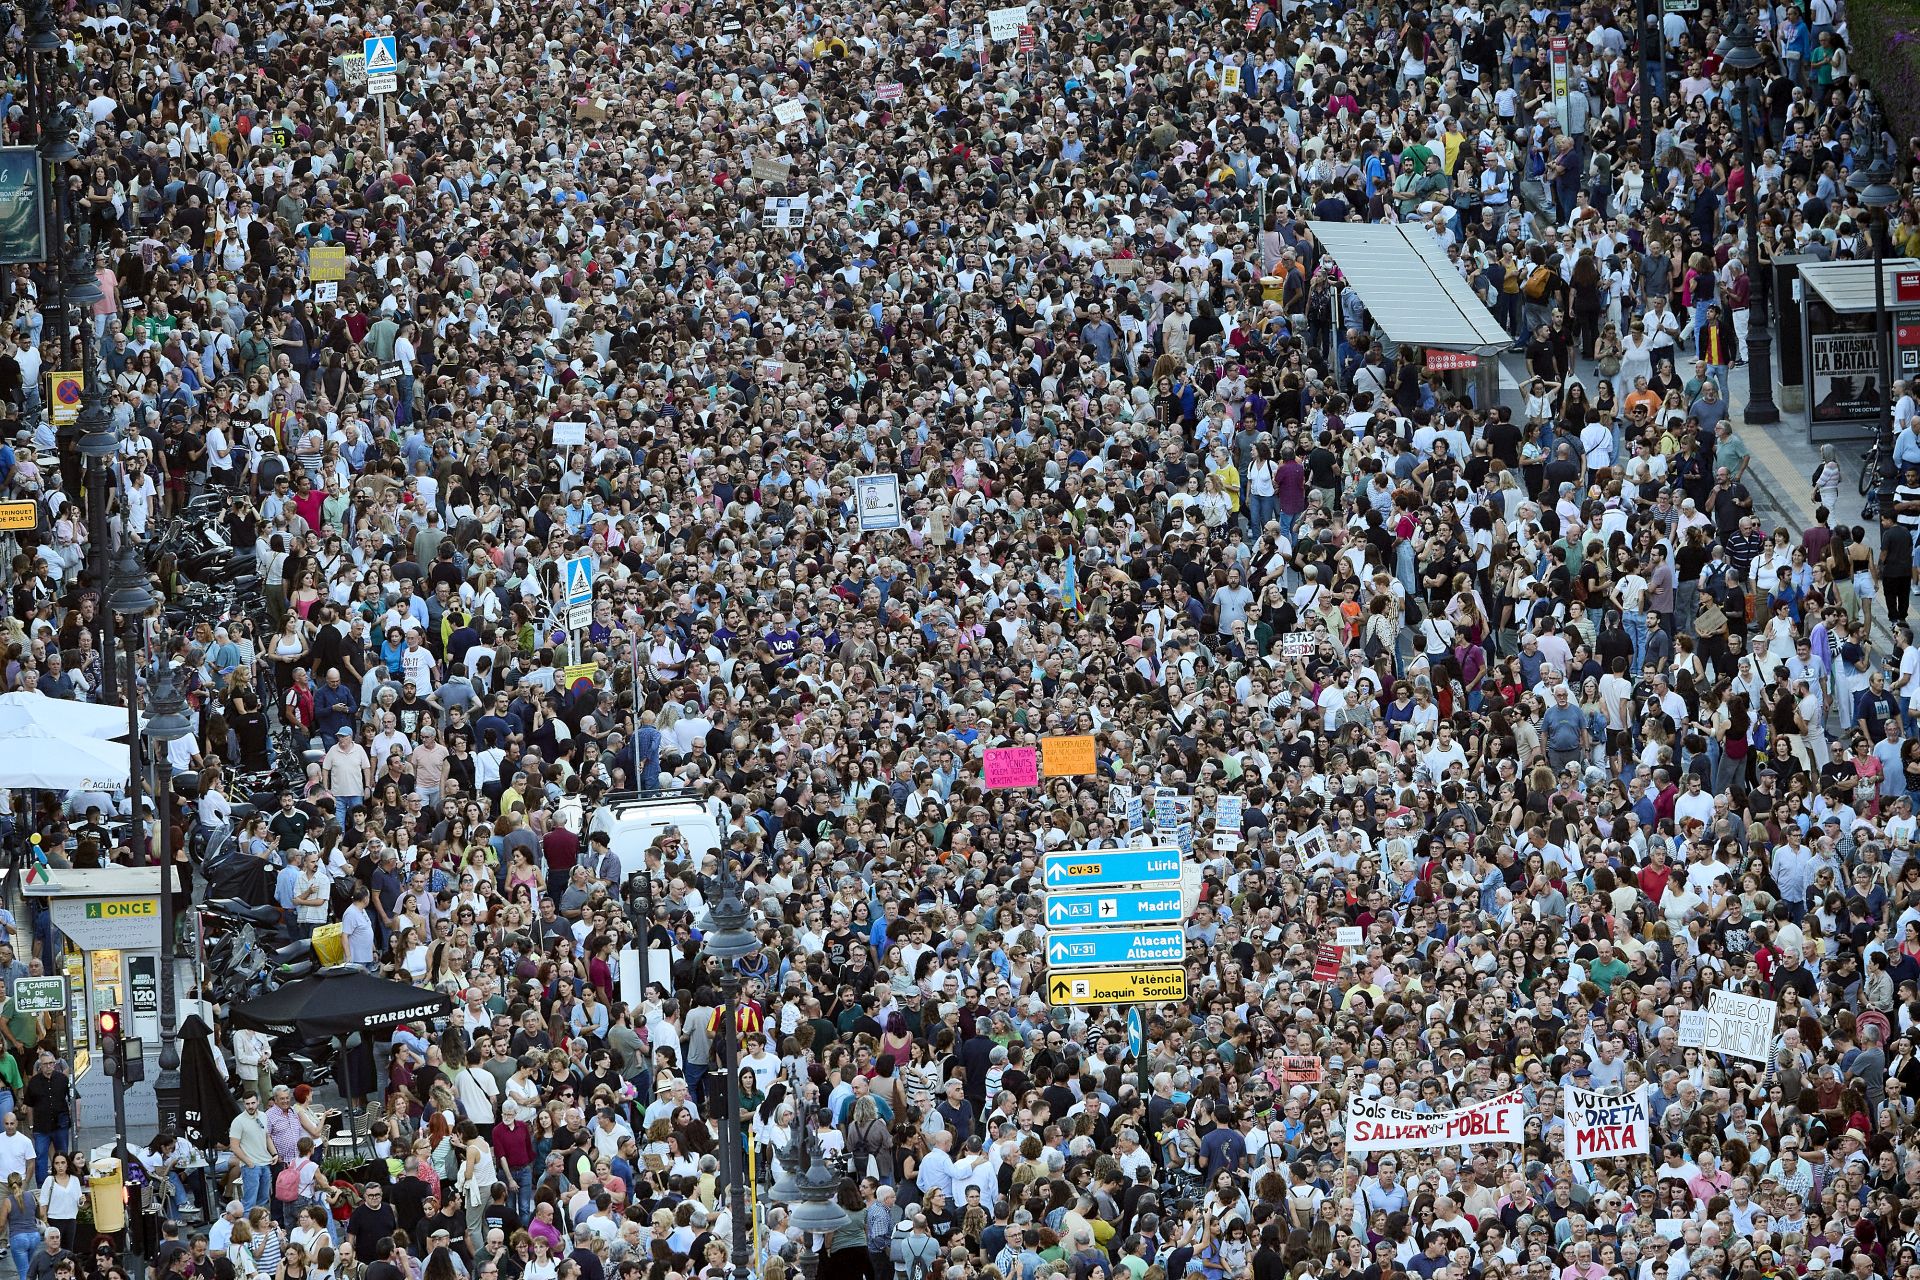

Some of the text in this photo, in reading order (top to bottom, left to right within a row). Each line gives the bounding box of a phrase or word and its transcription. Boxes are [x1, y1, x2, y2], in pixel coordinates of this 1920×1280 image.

[1814, 339, 1874, 353] UN FANTASMA
[1815, 351, 1880, 371] LA BATALL
[772, 640, 795, 651] Volt
[1011, 767, 1024, 775] TOTA
[990, 776, 1013, 785] VERITAT
[1069, 859, 1179, 875] CV-35 Llíria
[107, 902, 152, 915] ONCE
[1071, 899, 1181, 915] A-3 Madrid
[1071, 934, 1181, 954] V-31 Alacant
[1126, 948, 1182, 959] Albacete
[29, 981, 60, 990] CARRER
[1130, 973, 1182, 985] València
[132, 989, 156, 1002] 120
[1142, 985, 1183, 997] Sorolla
[364, 1004, 441, 1017] STARBUCKS
[1573, 1091, 1636, 1109] VOTAR
[1352, 1098, 1385, 1119] Sols
[1391, 1109, 1412, 1121] els
[1585, 1103, 1645, 1127] DRETA
[1353, 1120, 1428, 1142] SALVEN
[1446, 1108, 1510, 1139] POBLE
[1576, 1124, 1637, 1156] MATA
